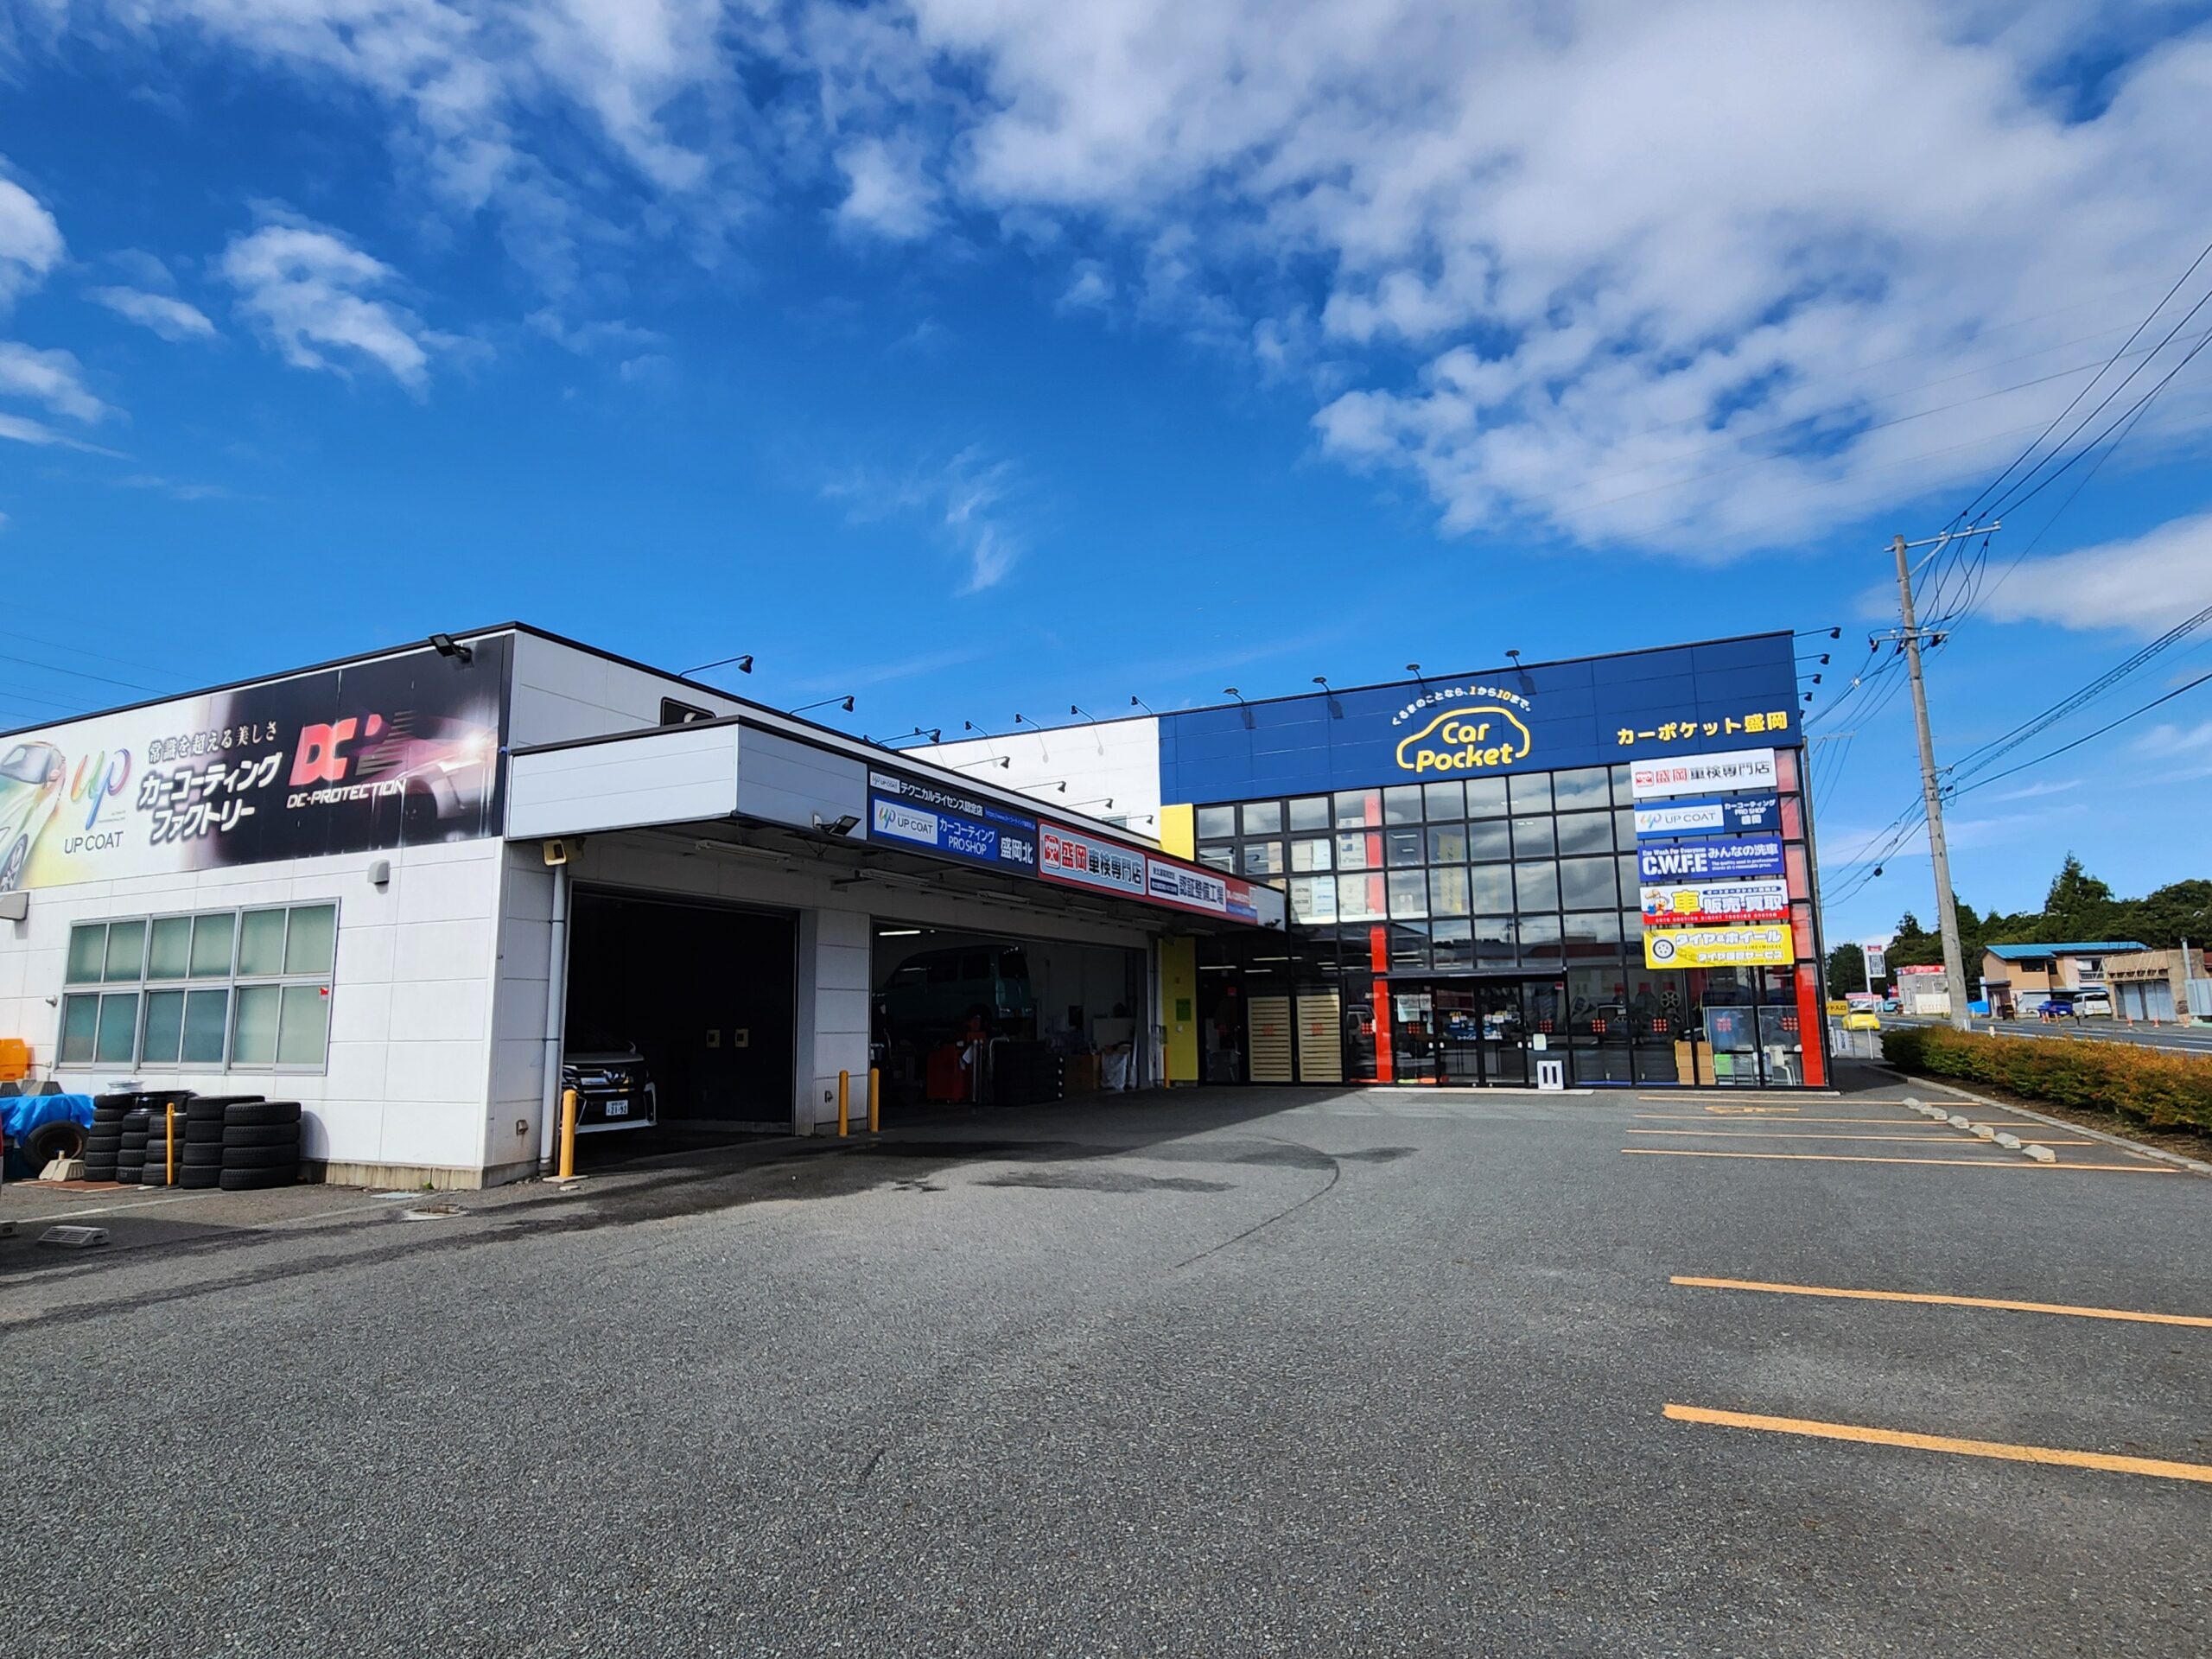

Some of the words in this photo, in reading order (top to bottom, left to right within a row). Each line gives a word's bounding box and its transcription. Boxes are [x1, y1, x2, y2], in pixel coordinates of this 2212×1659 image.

[149, 721, 277, 764] 常識を超える美しさ
[1442, 722, 1490, 744] Car
[1617, 711, 1788, 745] カーポケット盛岡
[1416, 743, 1513, 772] Pocket
[1656, 760, 1770, 784] 盛岡車検専門店
[139, 752, 283, 806] カーコーティング
[287, 779, 407, 809] DC-PROTECTION
[900, 782, 983, 817] テクニカルライセンス認定店
[151, 799, 255, 842] ファクトリー
[898, 817, 910, 829] UP
[911, 821, 933, 834] COAT
[939, 817, 995, 843] カーコーティング
[1665, 815, 1681, 823] UP
[1683, 812, 1716, 822] COAT
[64, 836, 83, 854] UP
[85, 831, 124, 850] COAT
[1001, 836, 1033, 865] 盛岡北
[1708, 843, 1778, 859] みんなの洗車
[1061, 840, 1141, 886] 盛岡車検専門店
